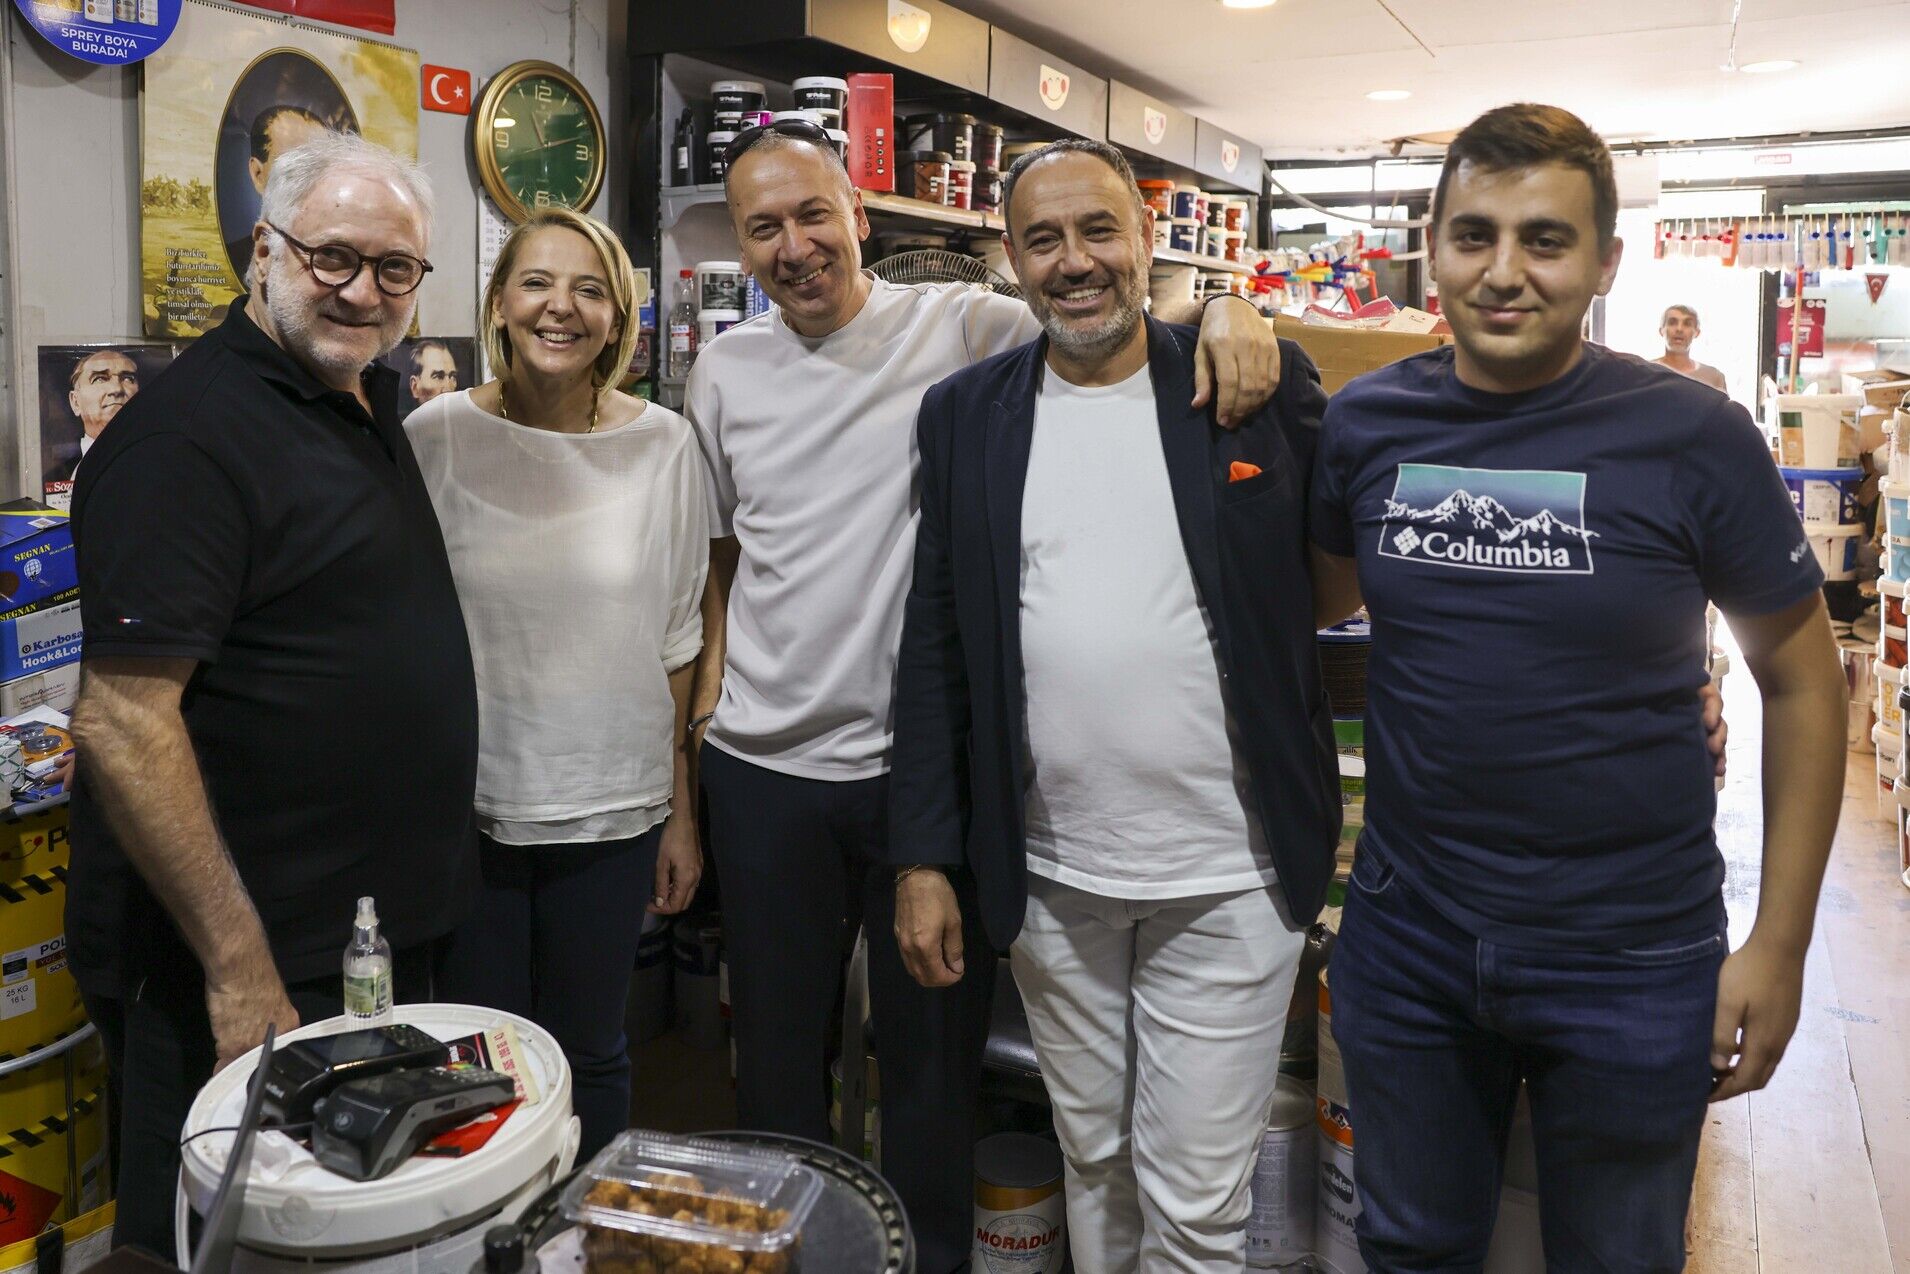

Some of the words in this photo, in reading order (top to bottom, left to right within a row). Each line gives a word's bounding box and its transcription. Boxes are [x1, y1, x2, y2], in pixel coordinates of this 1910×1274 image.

[61, 27, 101, 43] SPREY
[104, 34, 138, 49] BOYA
[72, 40, 128, 59] BURADA!
[534, 84, 552, 103] 12
[495, 131, 509, 149] 9
[576, 144, 589, 161] 3
[167, 312, 179, 320] bir
[14, 543, 51, 563] SEGNAN
[1421, 531, 1571, 568] Columbia
[53, 592, 64, 602] 100
[0, 603, 37, 622] SEGNAN
[33, 630, 83, 652] Karbosa
[6, 989, 16, 998] 25
[17, 984, 29, 993] KG
